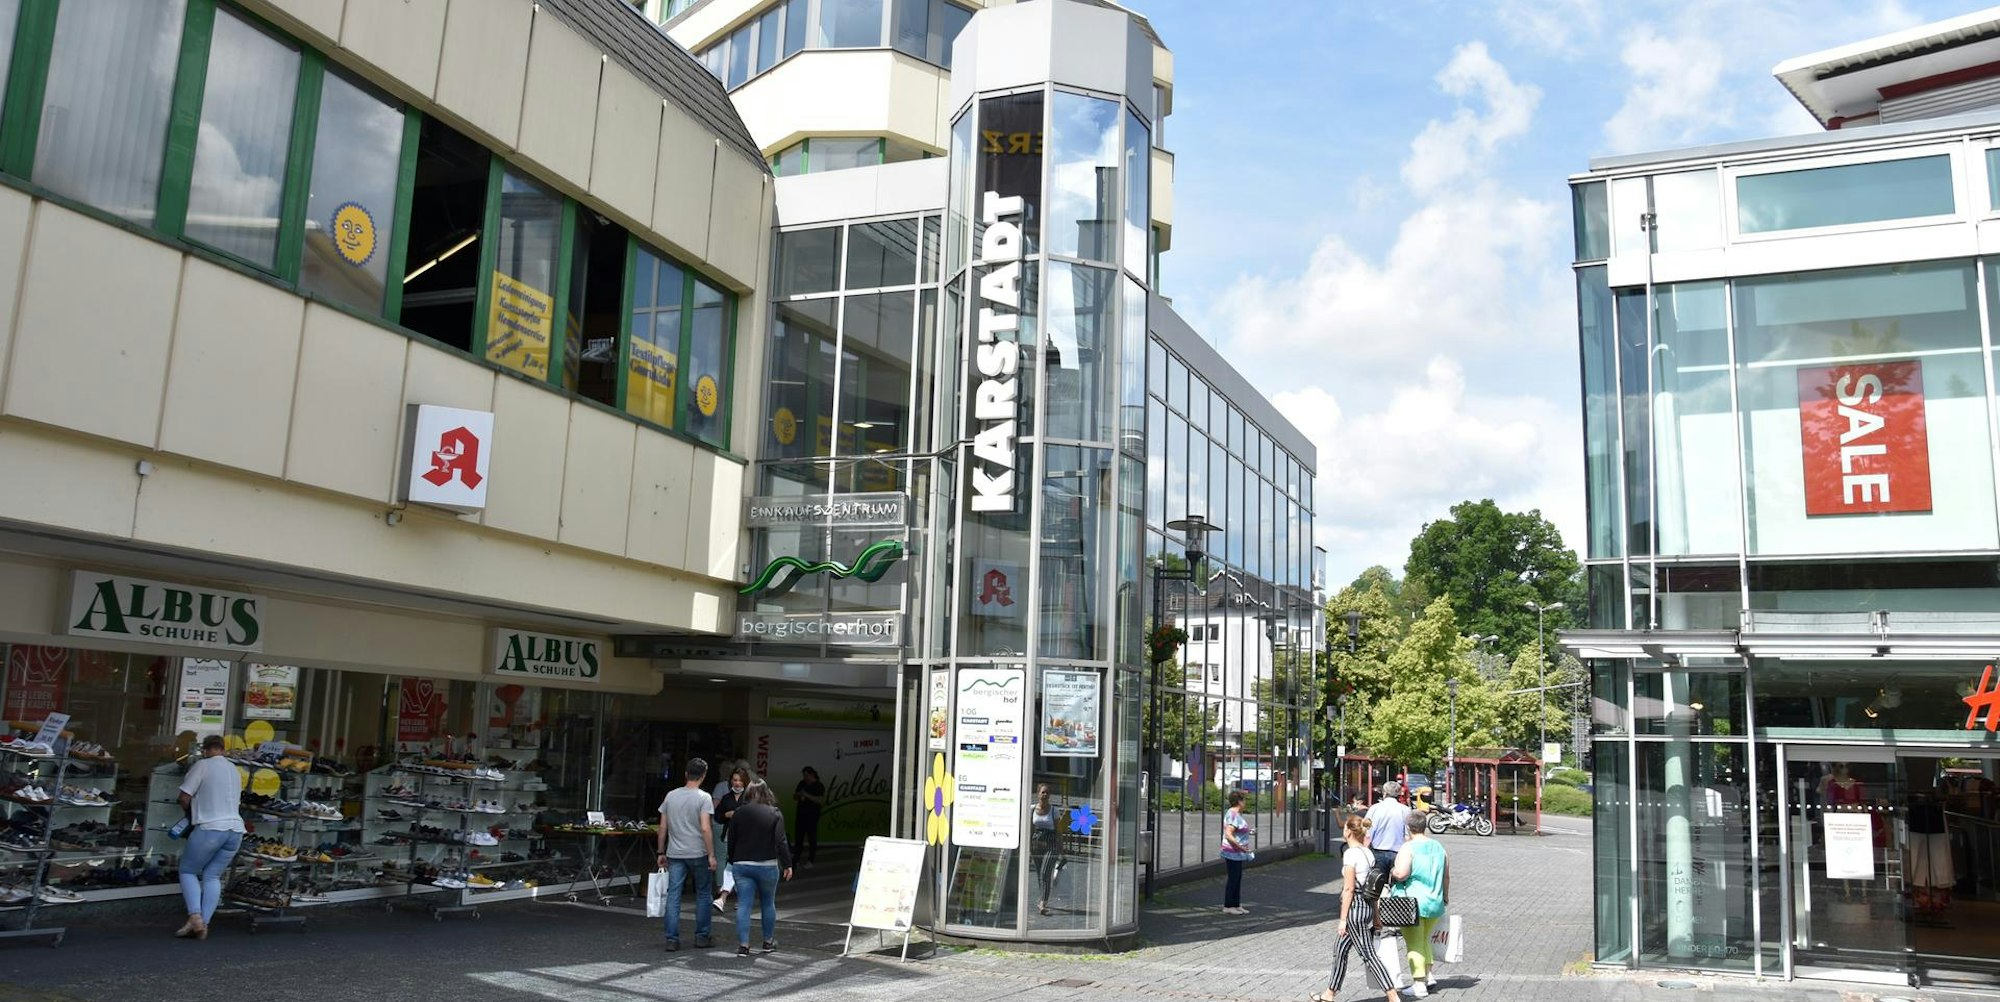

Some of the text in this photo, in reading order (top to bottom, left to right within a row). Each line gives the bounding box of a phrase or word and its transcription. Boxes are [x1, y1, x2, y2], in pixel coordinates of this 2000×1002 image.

[972, 190, 1025, 511] KARSTADT
[1836, 373, 1891, 505] SALE
[751, 502, 898, 519] EINKAUFSZENTRUM
[73, 579, 260, 646] ALBUS
[139, 624, 218, 643] SCHUHE
[742, 618, 894, 637] bergischerhof
[498, 633, 599, 678] ALBUS
[532, 664, 576, 677] SCHUHE
[973, 688, 1018, 697] bergischer
[1003, 696, 1018, 704] hof
